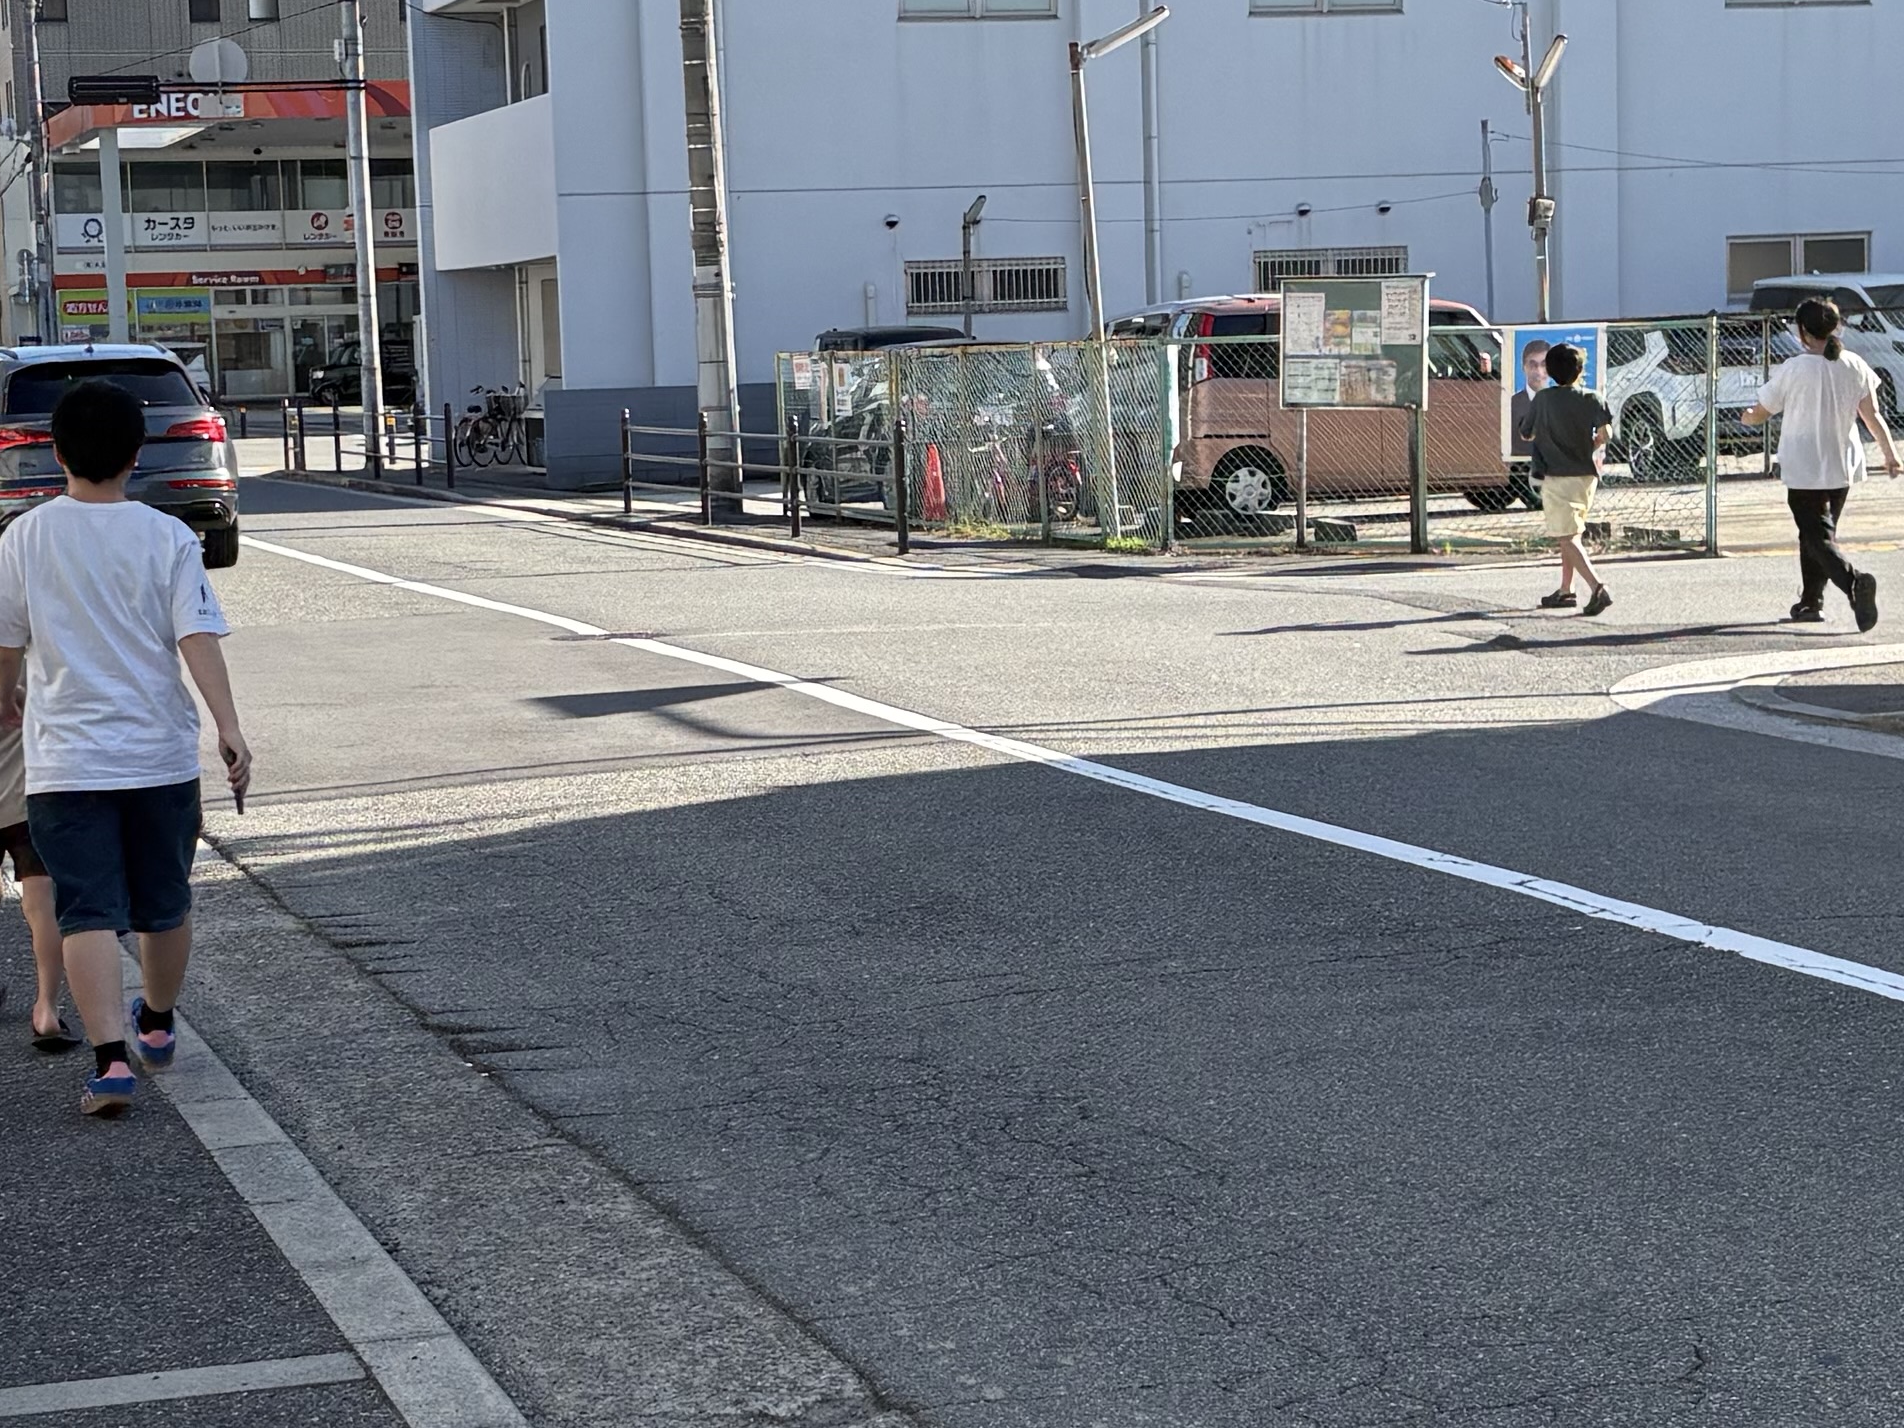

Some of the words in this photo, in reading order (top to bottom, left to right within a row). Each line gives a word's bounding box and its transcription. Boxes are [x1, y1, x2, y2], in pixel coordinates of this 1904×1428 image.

[133, 93, 201, 118] ENEO
[144, 217, 195, 231] カースタ
[151, 232, 189, 241] レンタカー
[192, 274, 228, 285] Service
